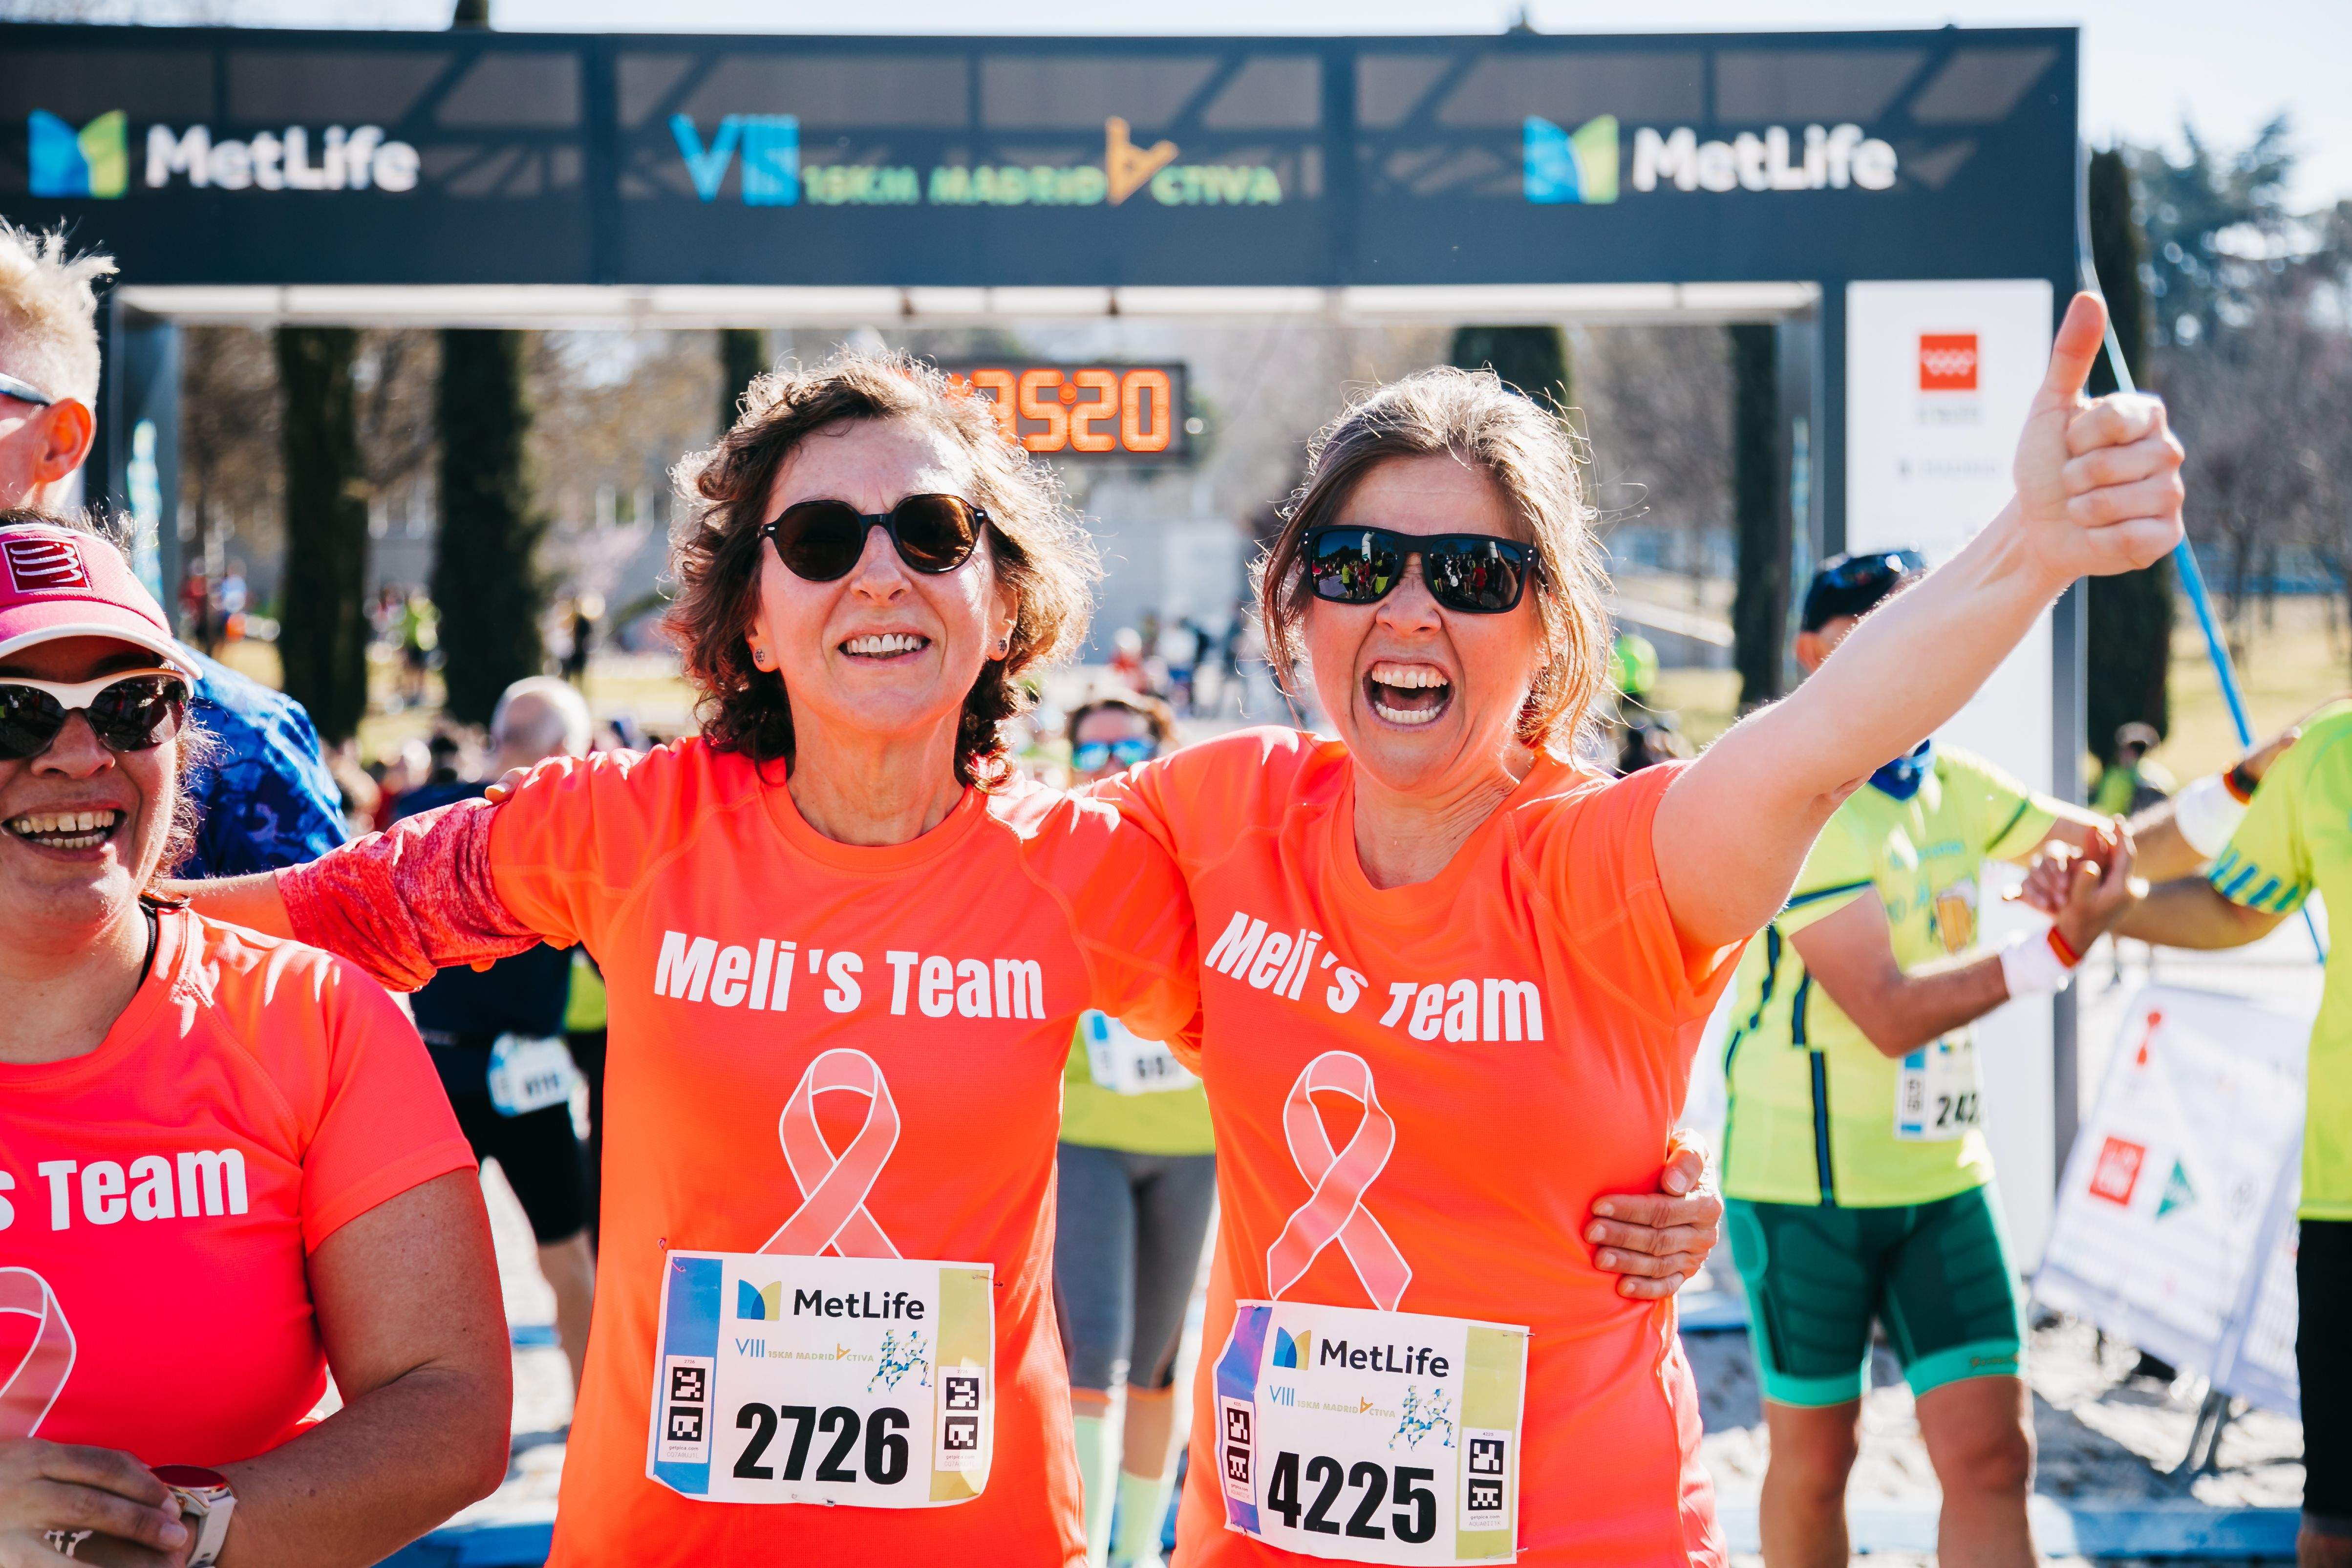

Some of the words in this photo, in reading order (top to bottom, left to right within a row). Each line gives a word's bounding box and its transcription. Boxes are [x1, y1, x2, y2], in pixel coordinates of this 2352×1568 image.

[145, 124, 421, 192] MetLife
[1632, 123, 1898, 192] MetLife
[886, 950, 1047, 1019] Team
[1379, 978, 1544, 1043] Team
[38, 1148, 248, 1231] Team
[793, 1289, 925, 1320] MetLife
[735, 1338, 765, 1357] VIII
[768, 1351, 792, 1359] 15KM
[1320, 1338, 1449, 1378] MetLife
[1269, 1385, 1295, 1407] VIII
[1297, 1400, 1320, 1410] 15KM
[733, 1402, 910, 1485] 2726
[1267, 1451, 1436, 1544] 4225
